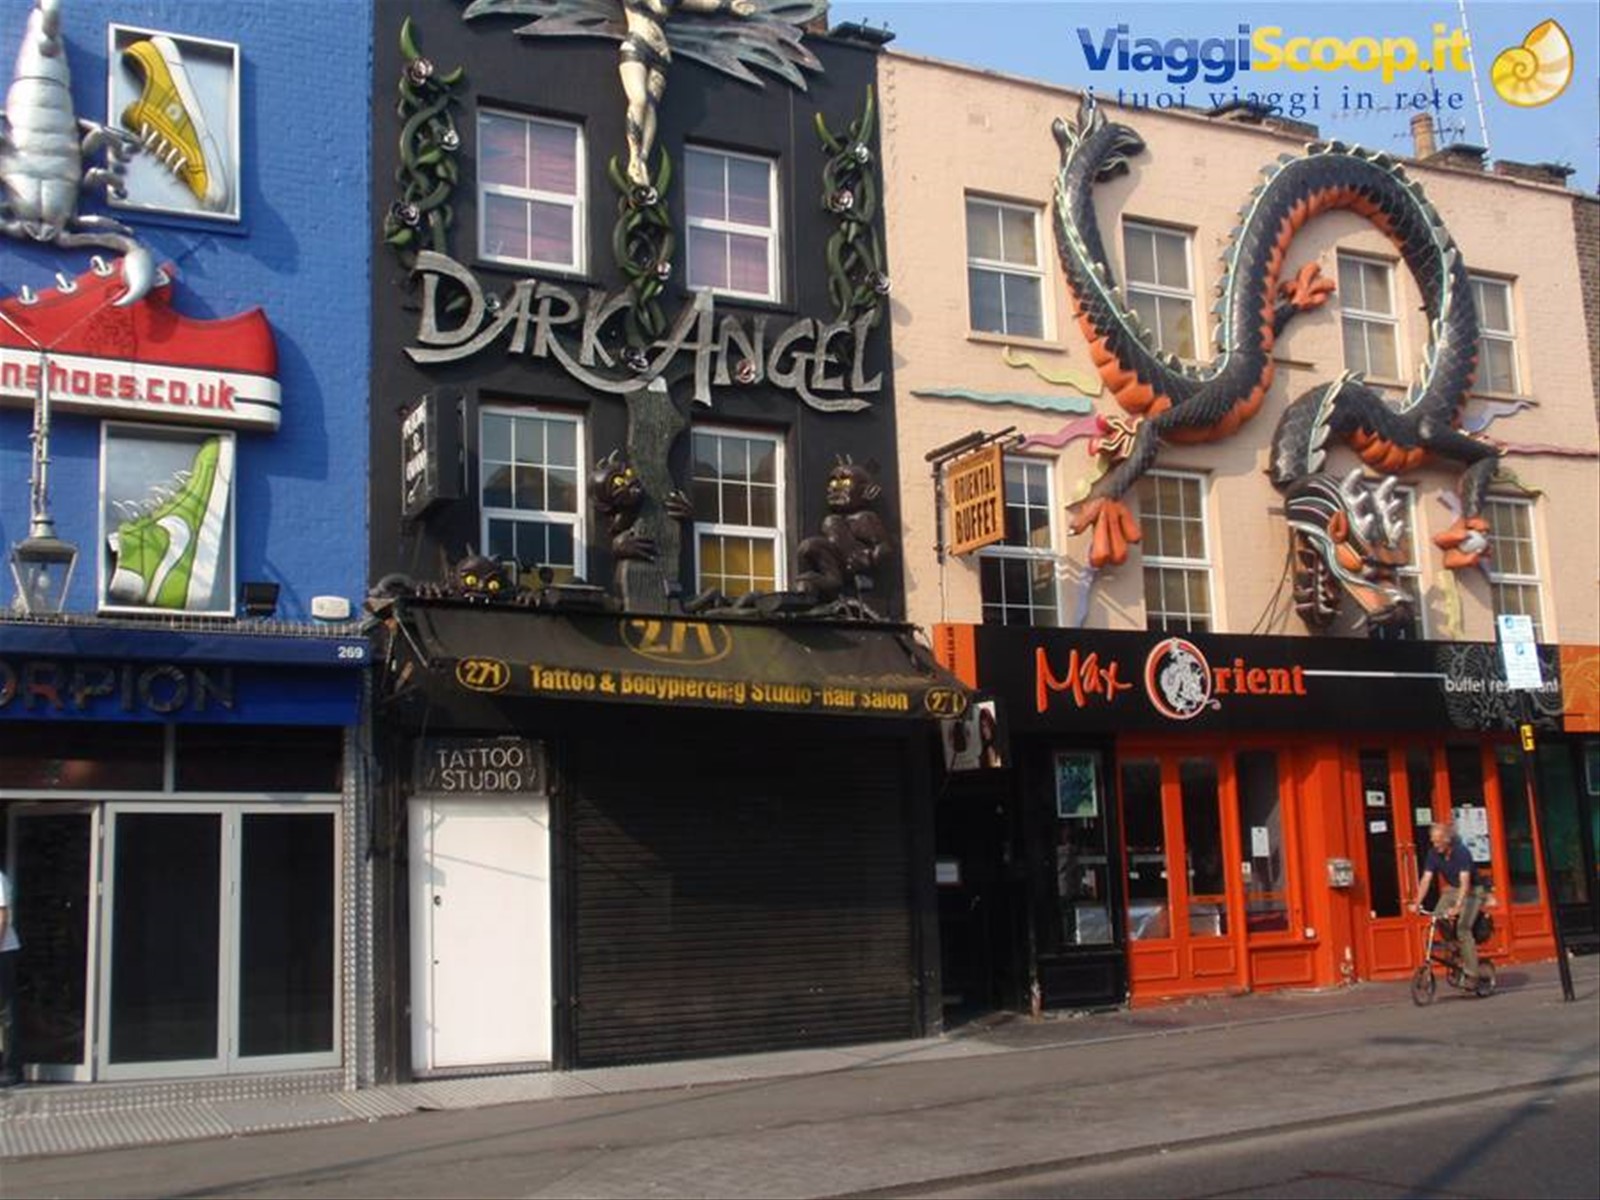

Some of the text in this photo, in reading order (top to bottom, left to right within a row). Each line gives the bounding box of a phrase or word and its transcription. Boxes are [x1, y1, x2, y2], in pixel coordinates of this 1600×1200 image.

[956, 497, 997, 544] BUFFET
[338, 646, 364, 660] 269
[464, 661, 501, 685] 271
[530, 665, 595, 691] Tattoo
[599, 674, 616, 693] &
[1036, 646, 1132, 713] Max
[437, 747, 523, 768] TATTOO
[441, 768, 521, 791] STUDIO
